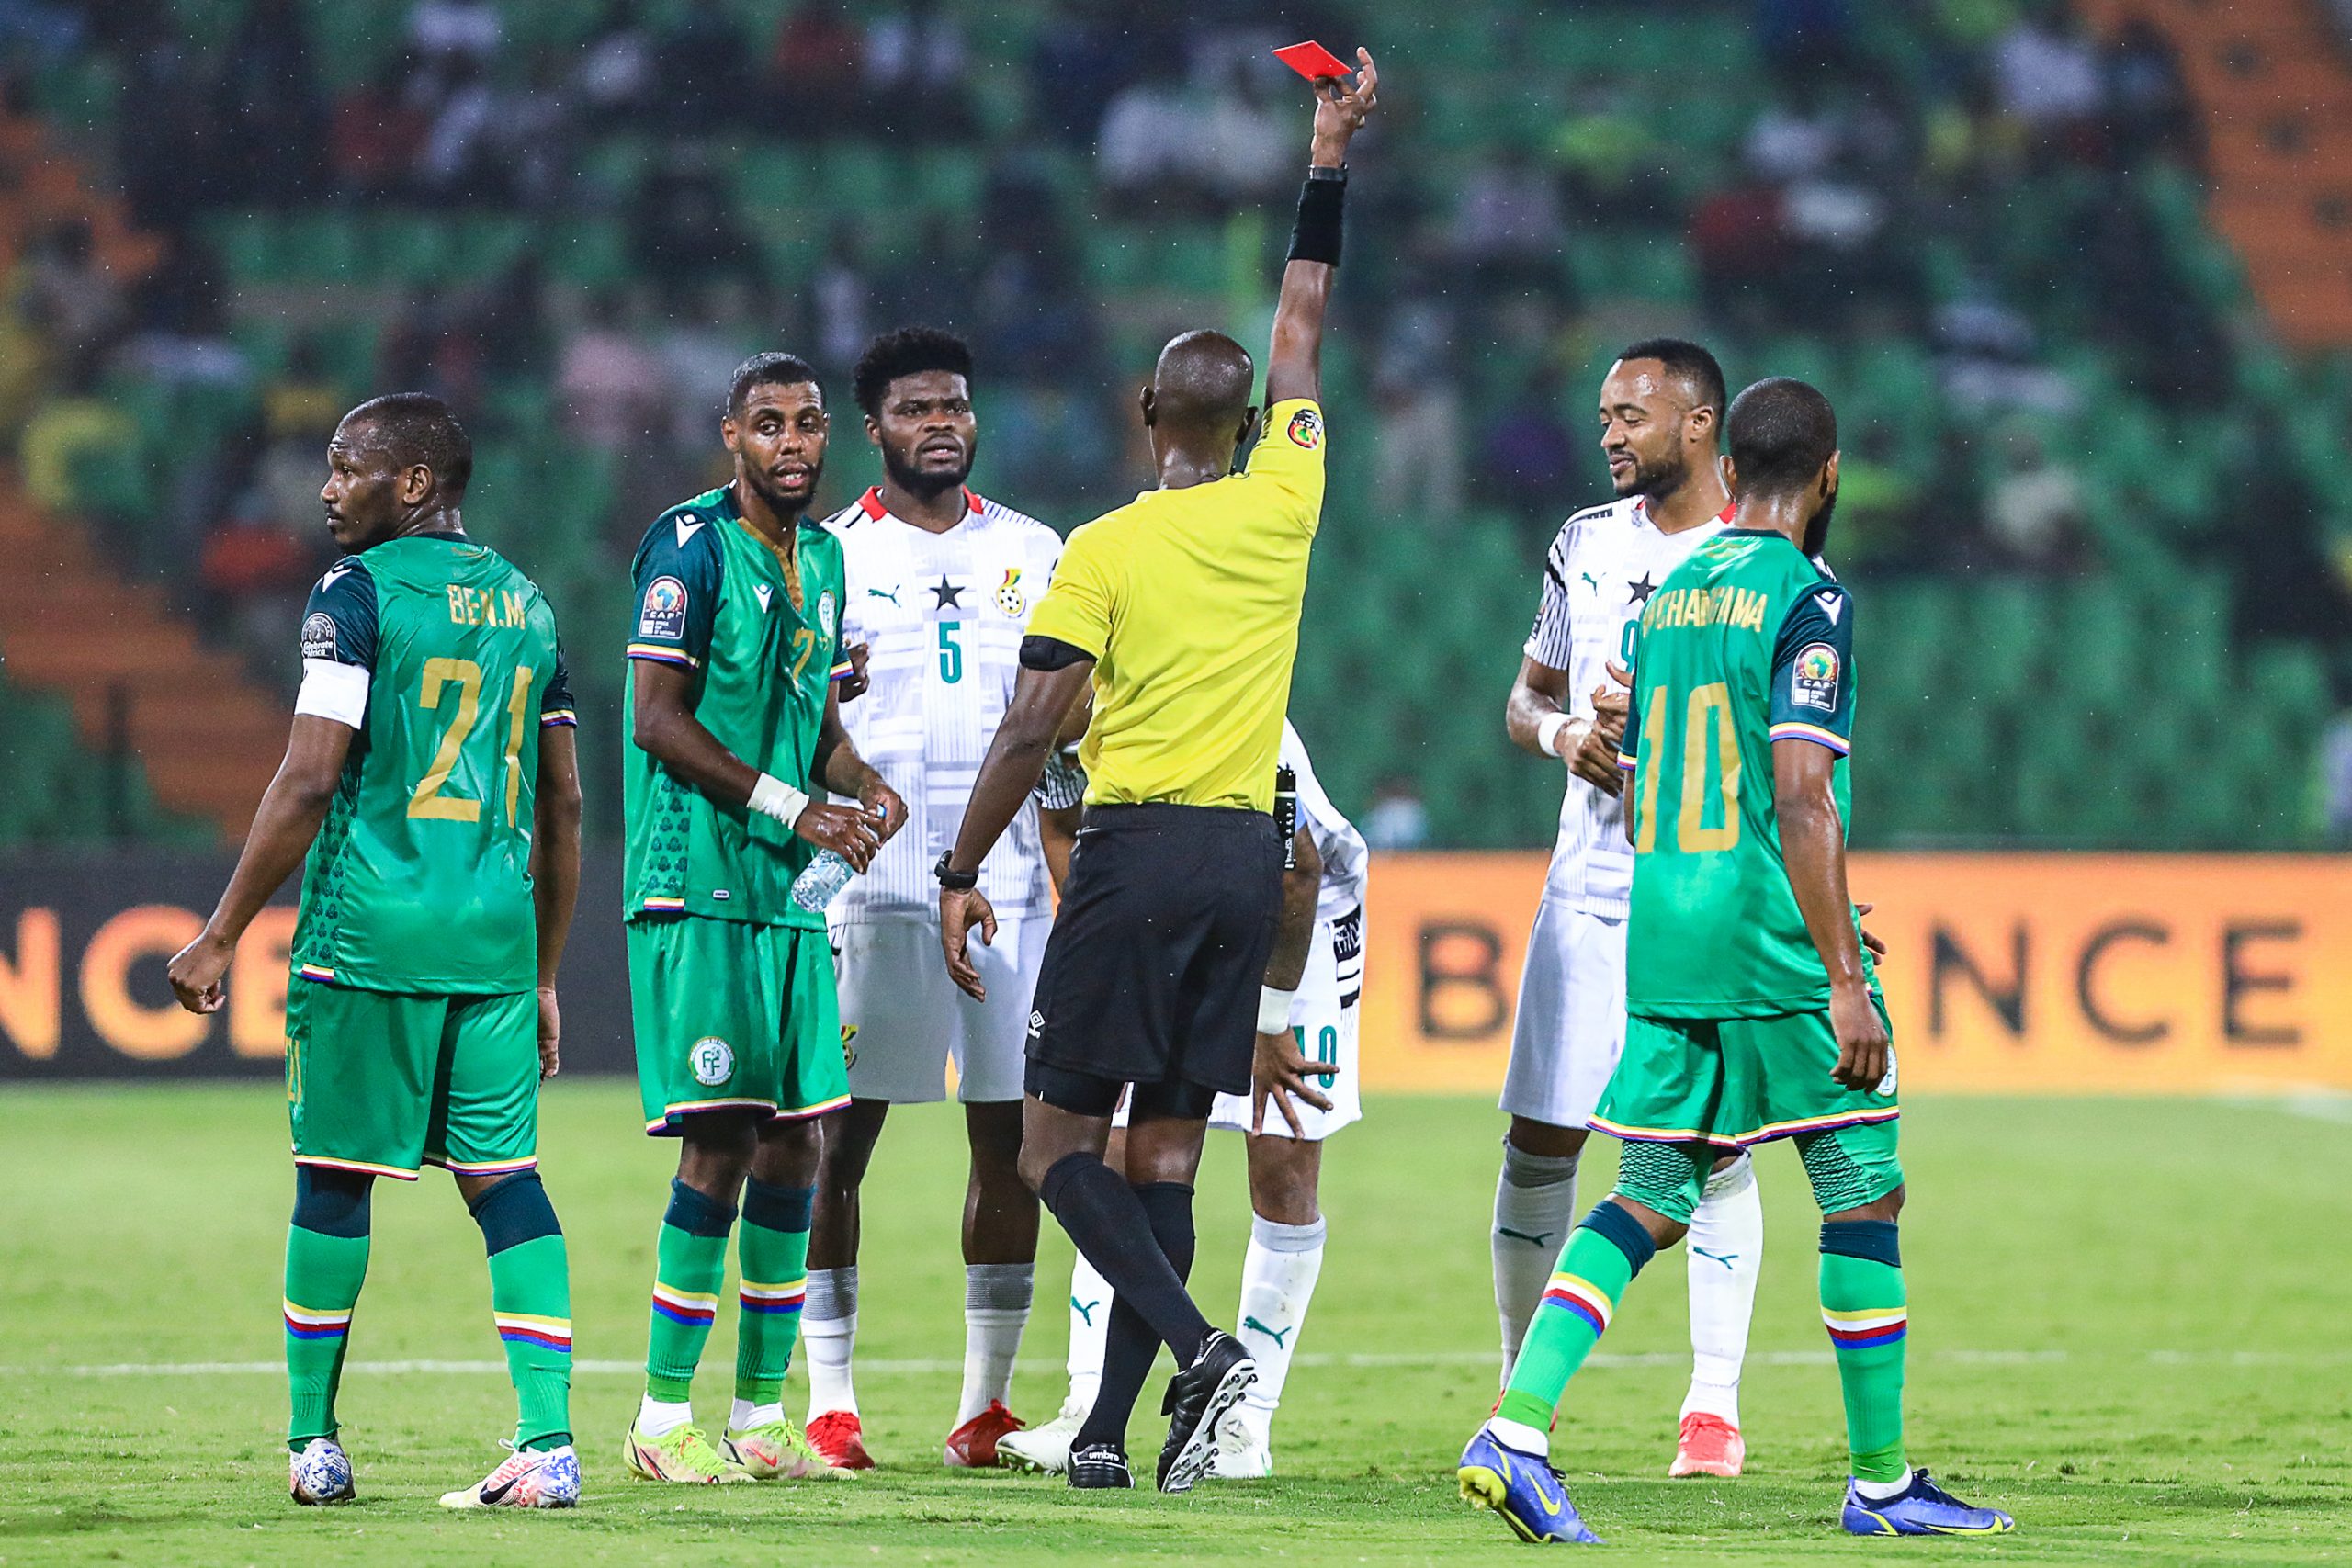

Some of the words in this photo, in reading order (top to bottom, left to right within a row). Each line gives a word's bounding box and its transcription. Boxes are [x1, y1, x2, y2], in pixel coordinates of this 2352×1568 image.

[793, 629, 816, 688] 7
[939, 622, 962, 684] 5
[1803, 679, 1831, 689] CAF
[406, 657, 533, 829] 21
[1635, 682, 1742, 854] 10
[1089, 1450, 1120, 1461] umbro
